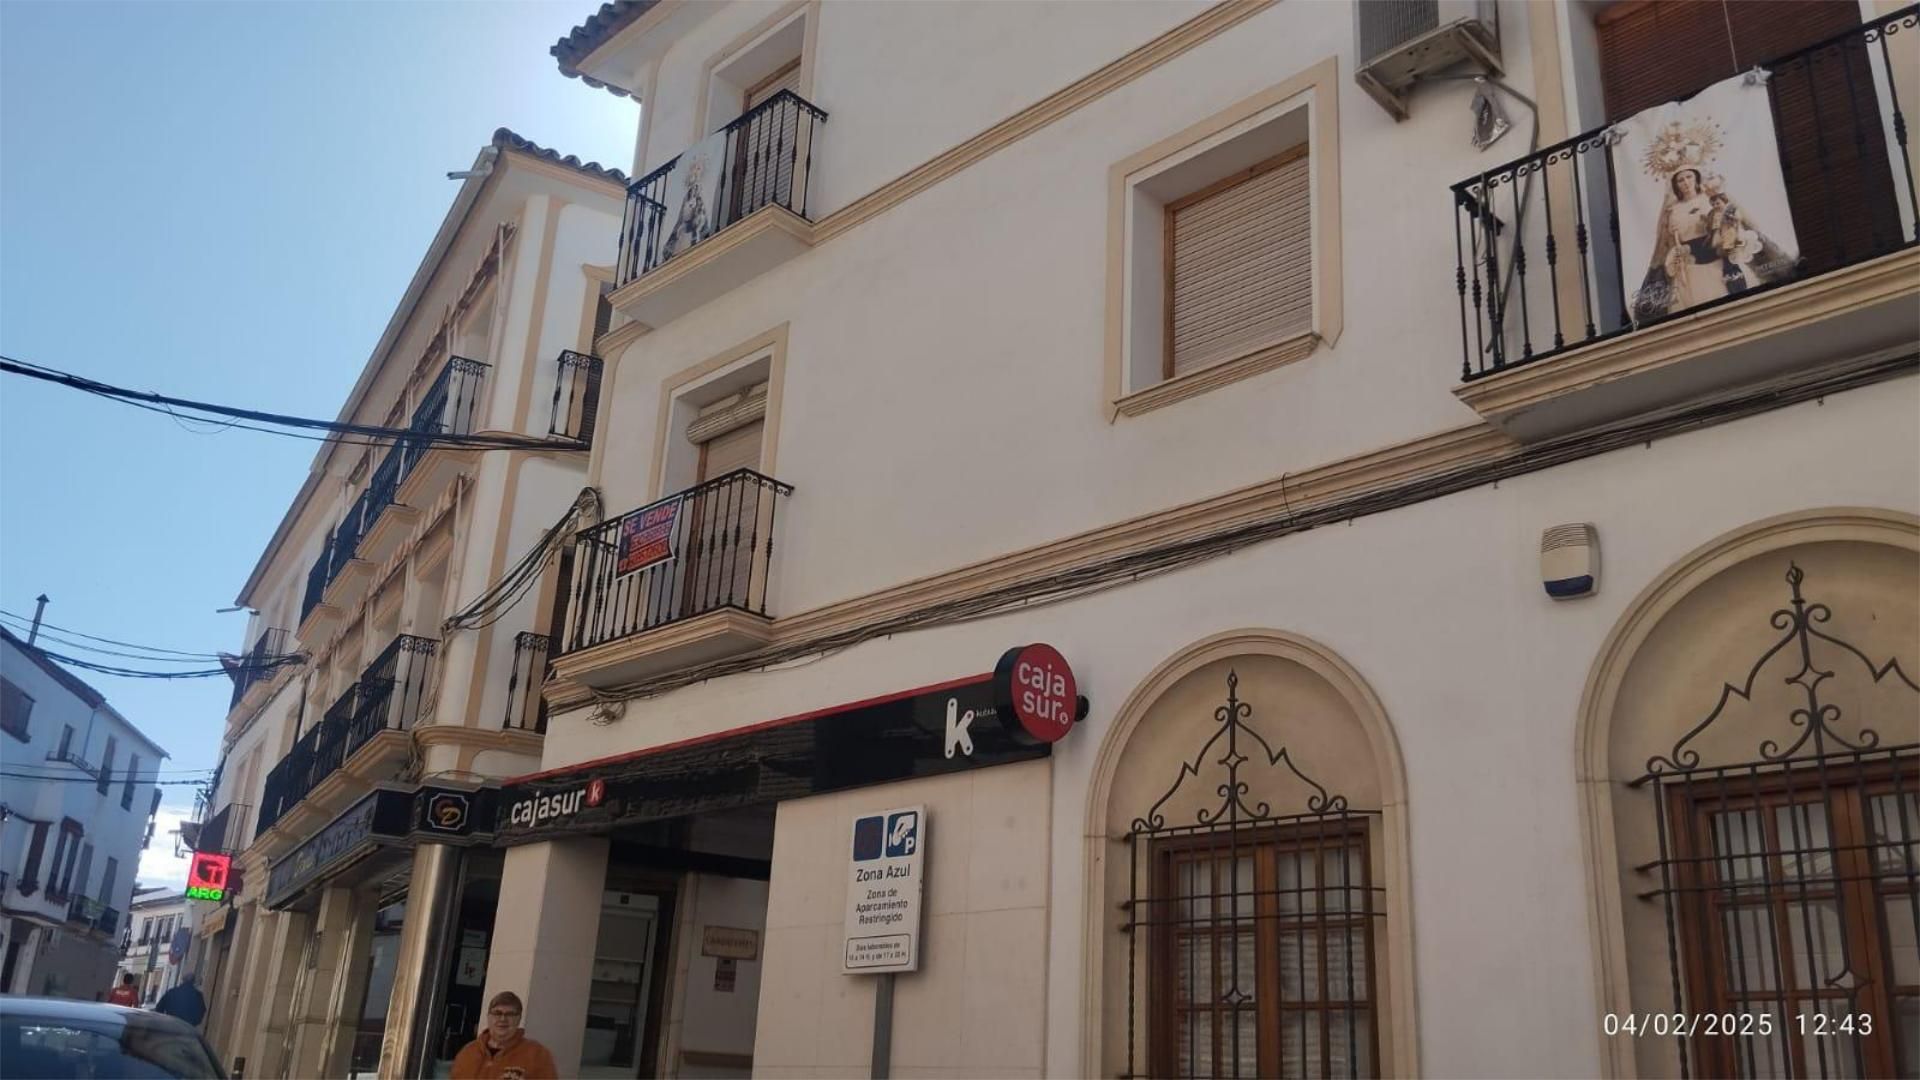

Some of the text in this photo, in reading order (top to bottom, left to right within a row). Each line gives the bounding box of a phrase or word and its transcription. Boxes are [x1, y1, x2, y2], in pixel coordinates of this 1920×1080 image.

[623, 501, 679, 536] SE VENDE
[1019, 662, 1066, 697] caja
[1022, 690, 1063, 721] sur
[945, 697, 974, 759] k
[510, 789, 586, 828] cajasur
[856, 863, 911, 882] Zona Azul
[855, 899, 908, 914] Aparcamiento
[867, 887, 898, 900] Zona de
[858, 912, 903, 925] Restringido
